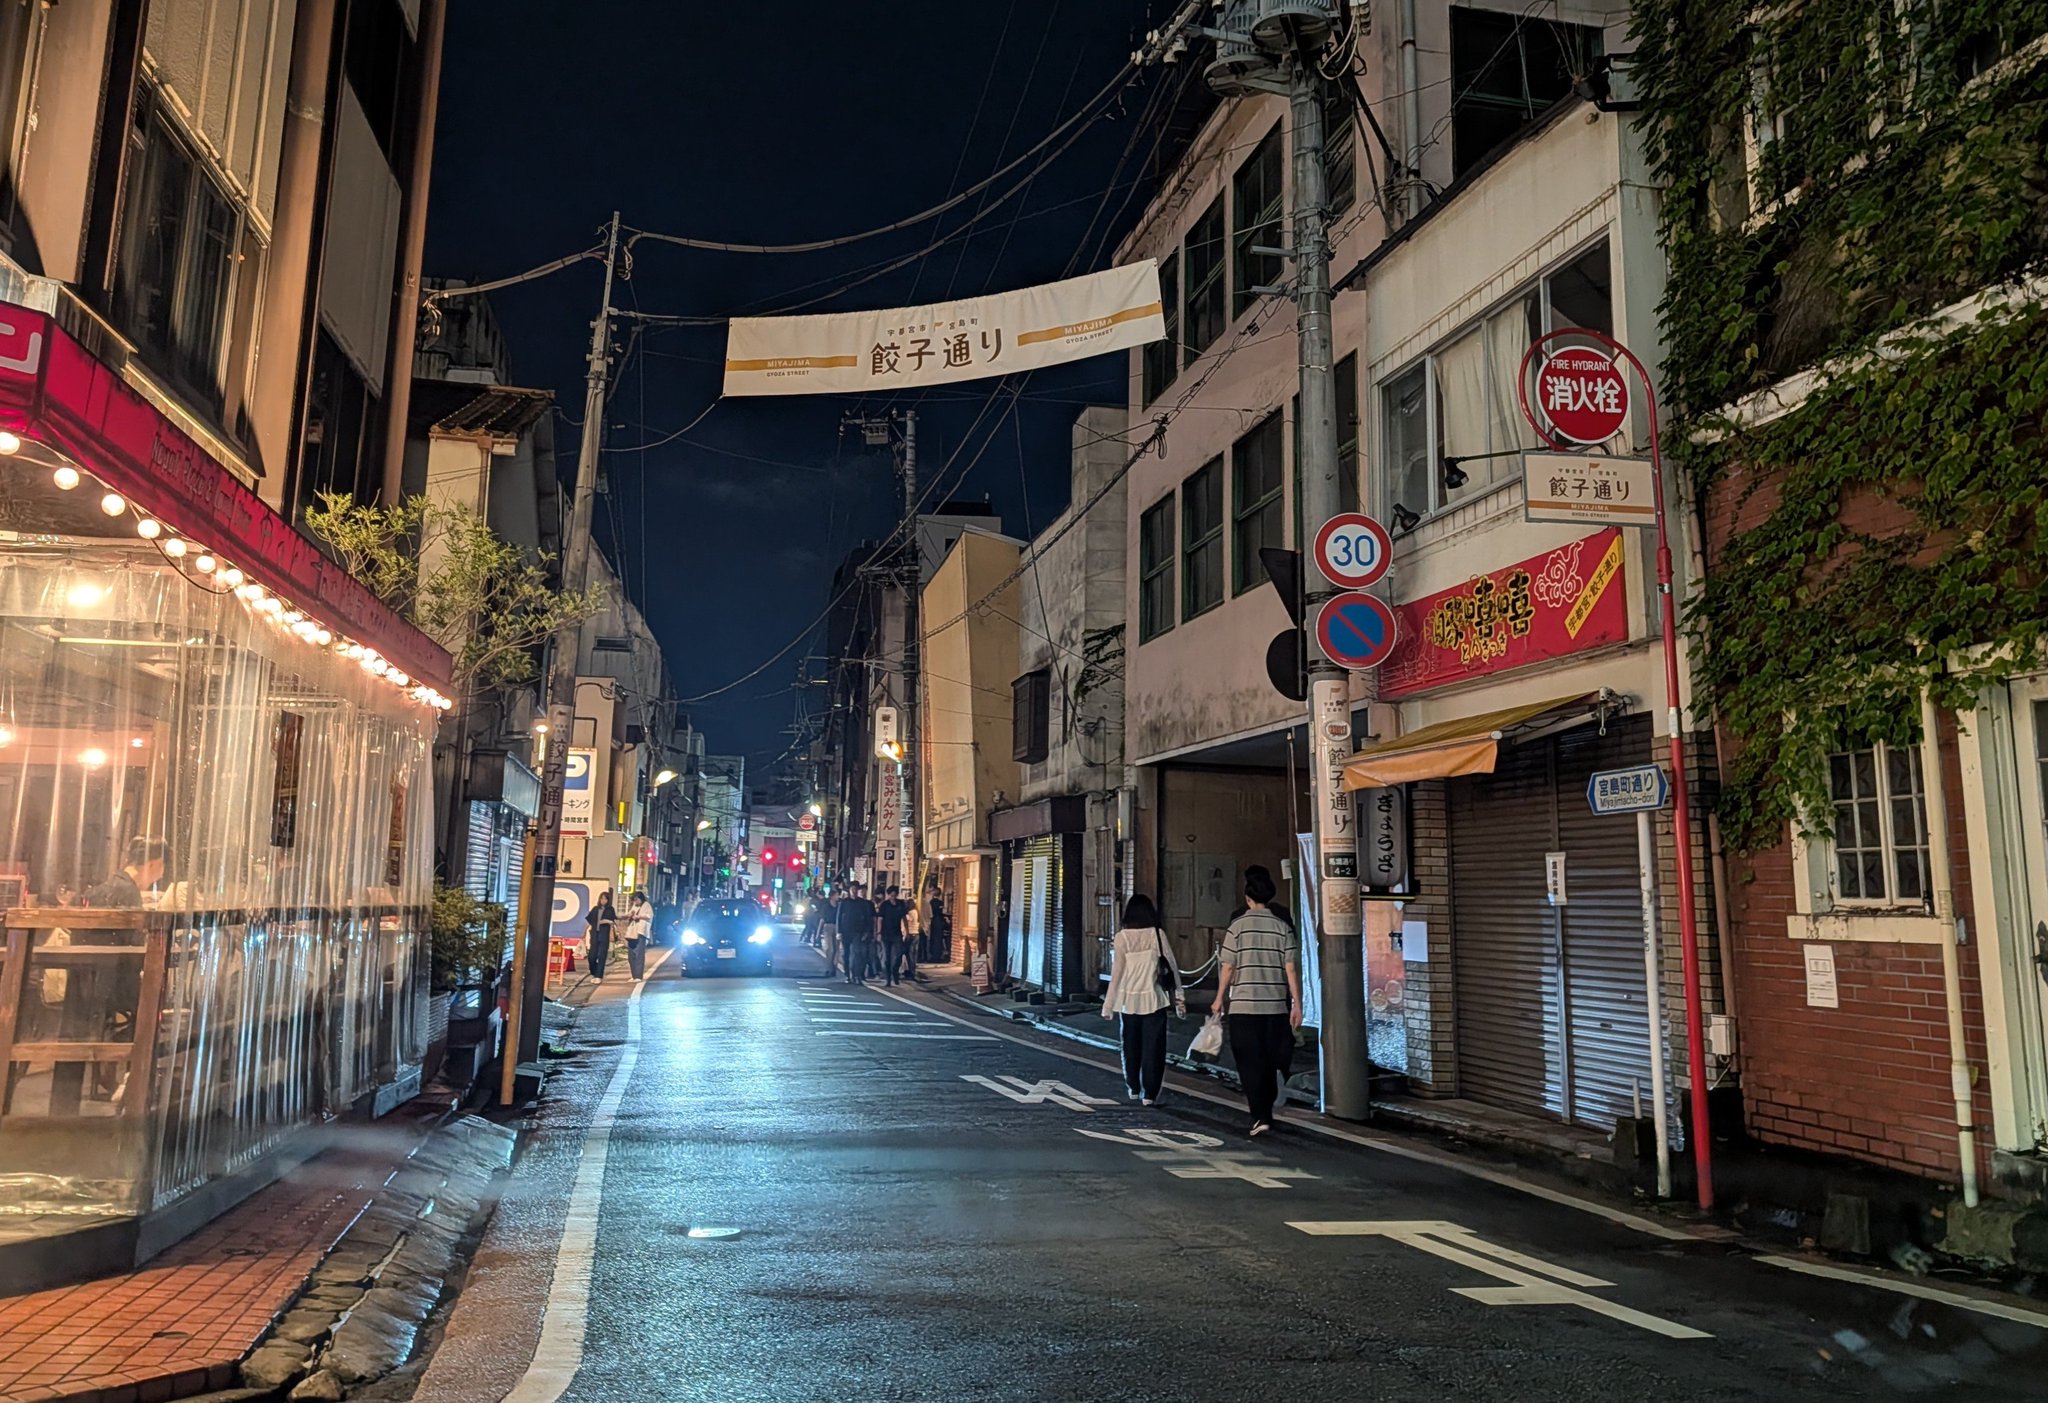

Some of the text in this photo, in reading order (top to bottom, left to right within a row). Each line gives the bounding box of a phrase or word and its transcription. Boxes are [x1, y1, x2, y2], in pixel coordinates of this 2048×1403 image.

[1064, 317, 1113, 336] MIYAJIMA
[1065, 328, 1114, 345] GYOZA STREET
[871, 328, 1003, 376] 餃子通り
[766, 359, 811, 369] MIYAJIMA
[1551, 359, 1611, 372] FIRE HYDRANT
[1547, 376, 1622, 414] 消火栓
[1548, 476, 1630, 502] 餃子通り
[1570, 503, 1610, 512] MIYAJIMA
[1332, 534, 1375, 567] 30
[541, 738, 567, 831] 餃子通り
[1328, 748, 1351, 833] 餃子通り
[1598, 771, 1654, 798] 宮島町通り
[562, 799, 590, 809] ーキング
[882, 763, 896, 831] 都宮みんみん
[886, 851, 893, 860] P
[1334, 867, 1351, 876] 4-2
